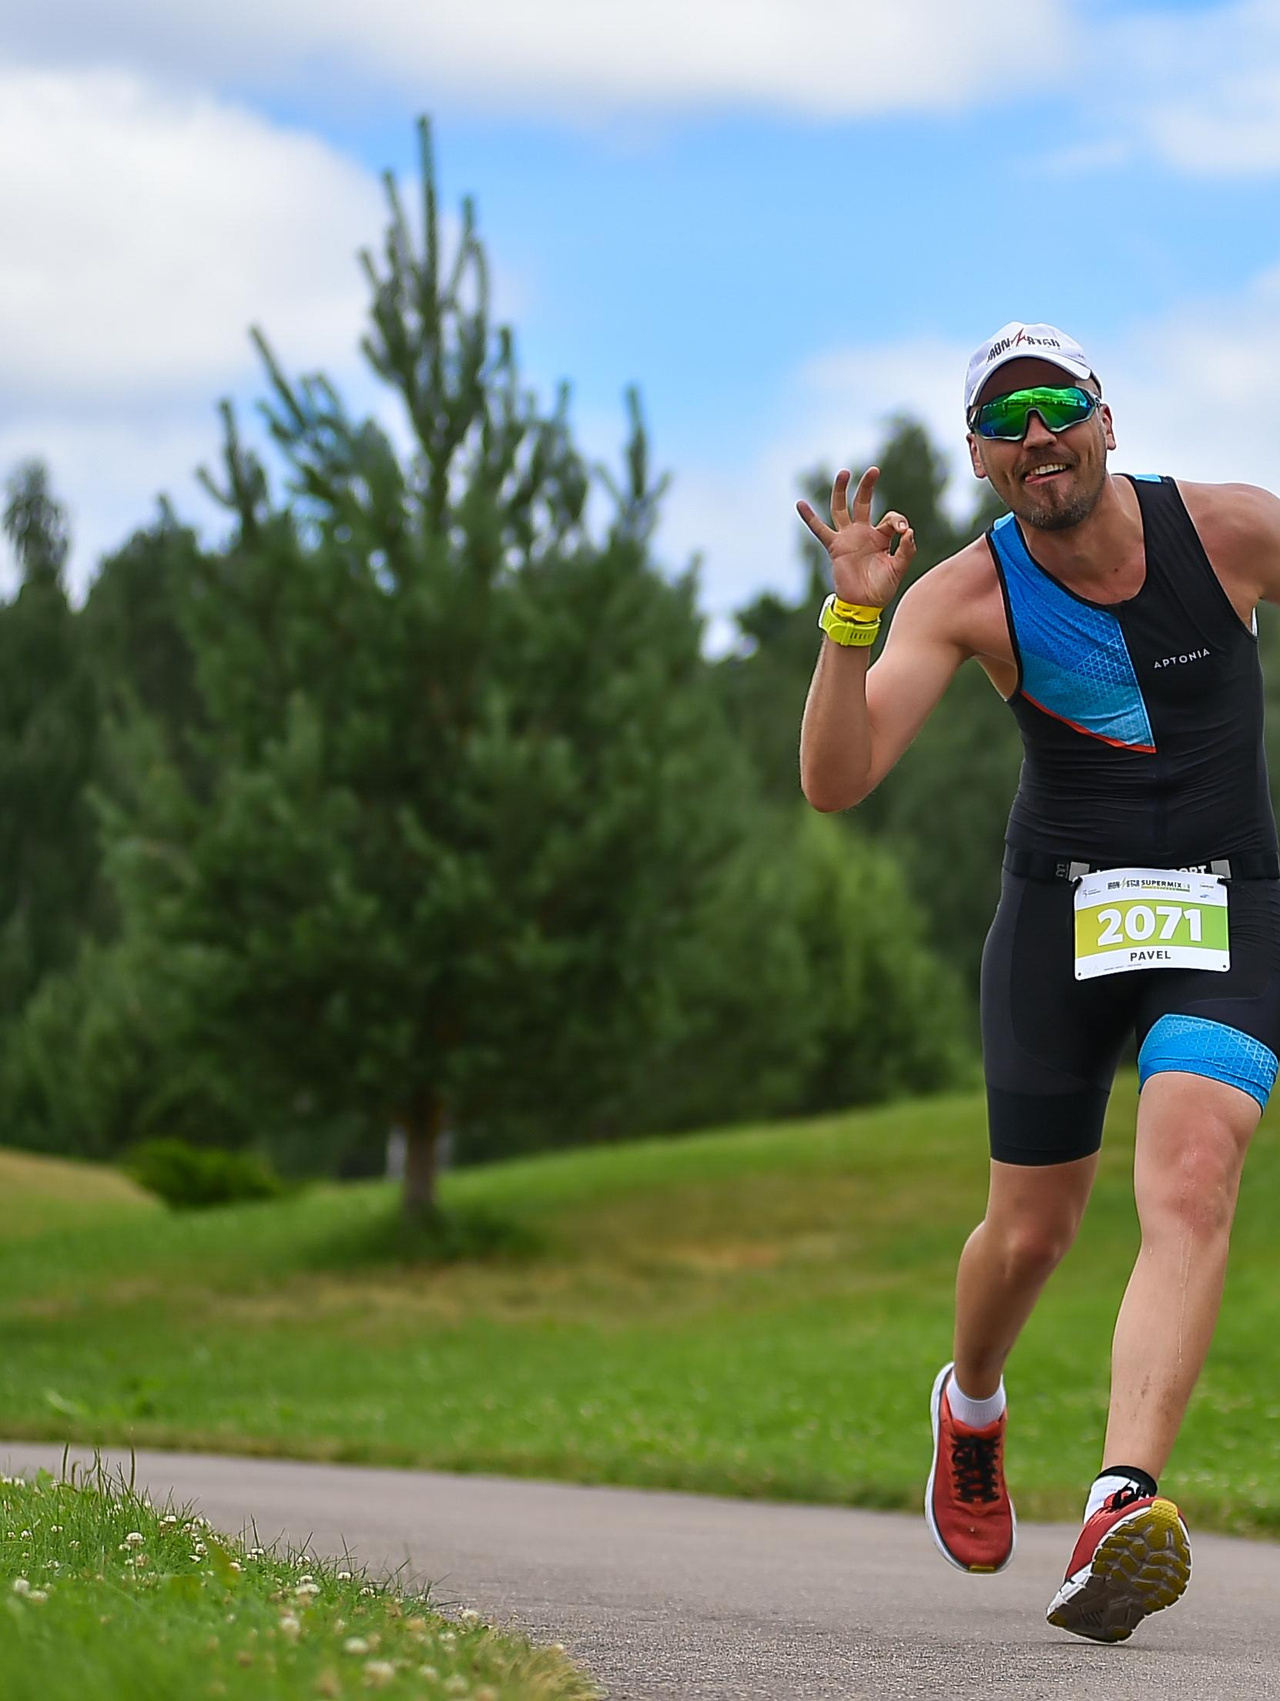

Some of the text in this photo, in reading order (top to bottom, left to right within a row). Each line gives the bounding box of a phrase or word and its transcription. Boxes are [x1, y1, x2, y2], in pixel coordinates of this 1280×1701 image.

[1153, 648, 1210, 669] APTONIA
[1141, 879, 1182, 888] SUPERMIX
[1097, 905, 1202, 946] 2071
[1130, 950, 1171, 962] PAVEL
